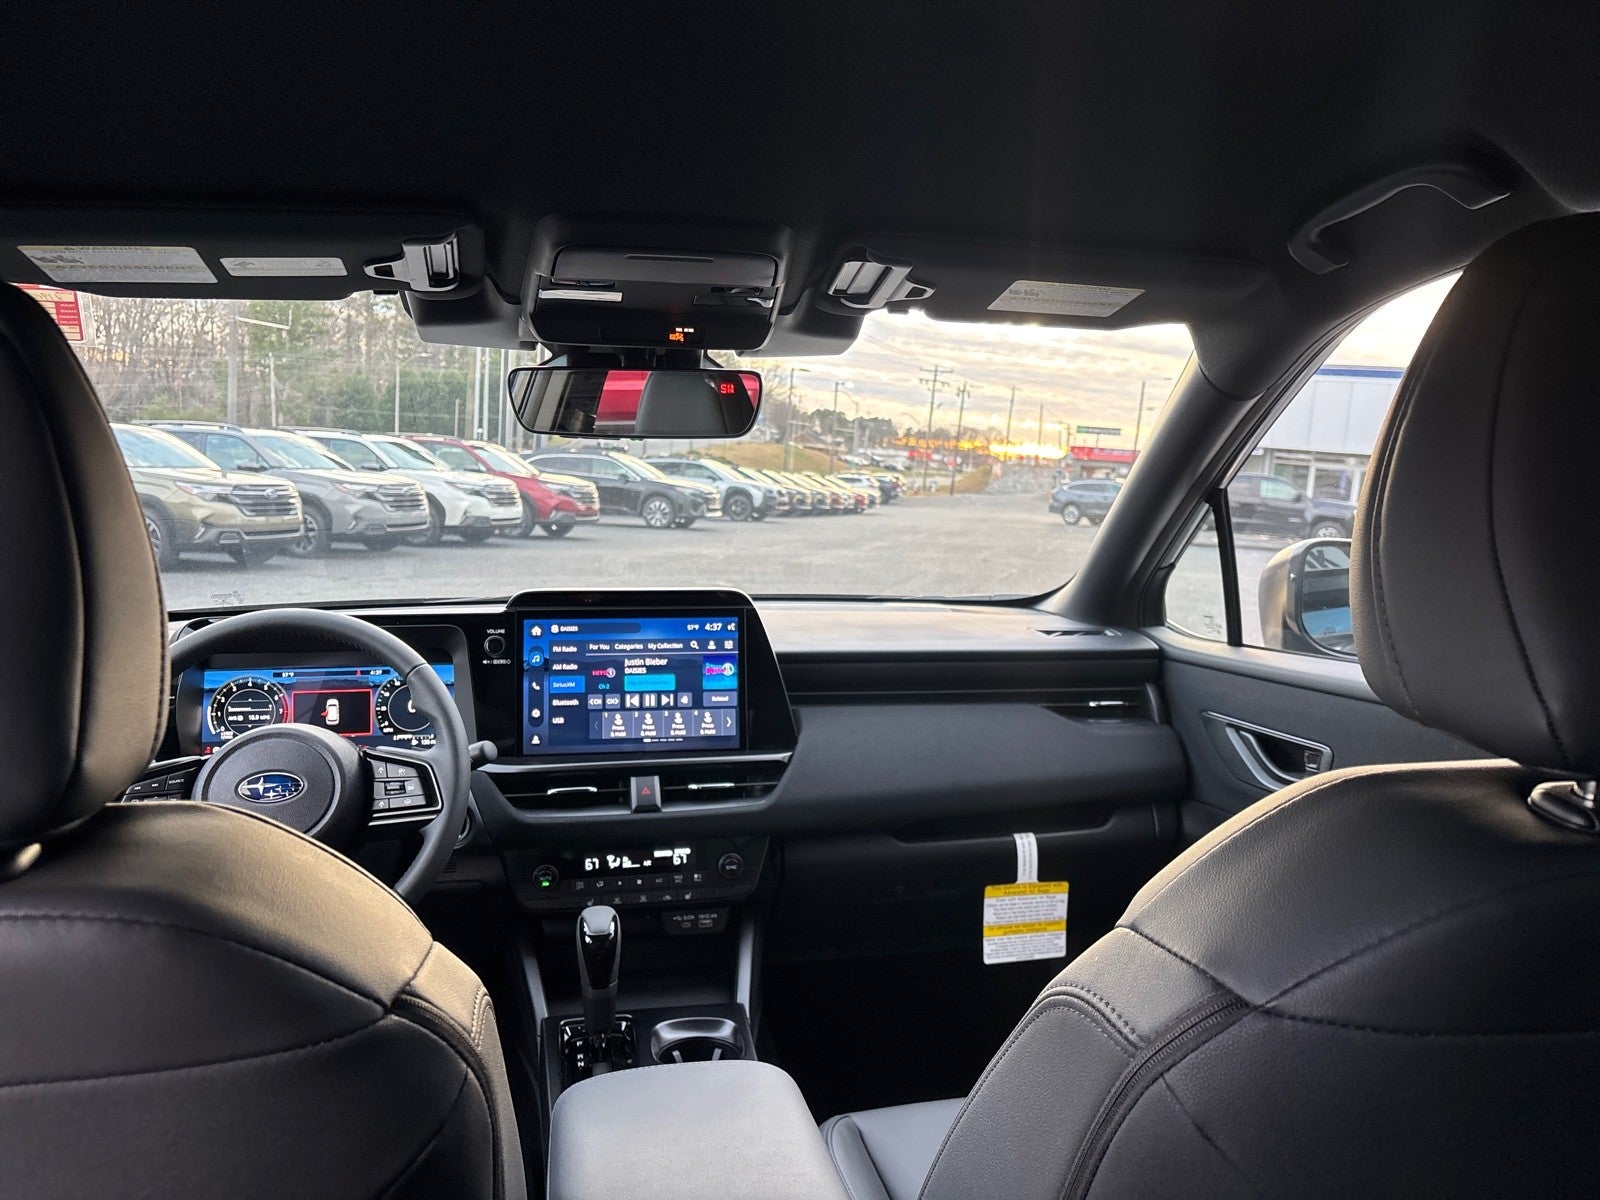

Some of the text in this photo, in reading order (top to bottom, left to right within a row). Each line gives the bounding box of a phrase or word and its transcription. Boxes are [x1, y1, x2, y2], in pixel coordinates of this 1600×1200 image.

[720, 384, 735, 394] SW
[704, 622, 723, 631] 4:37
[562, 645, 578, 653] Radio
[600, 643, 611, 651] You
[614, 643, 644, 652] Categories
[657, 642, 684, 650] Collection
[624, 657, 668, 667] Justin Bieber
[562, 663, 579, 671] Radio
